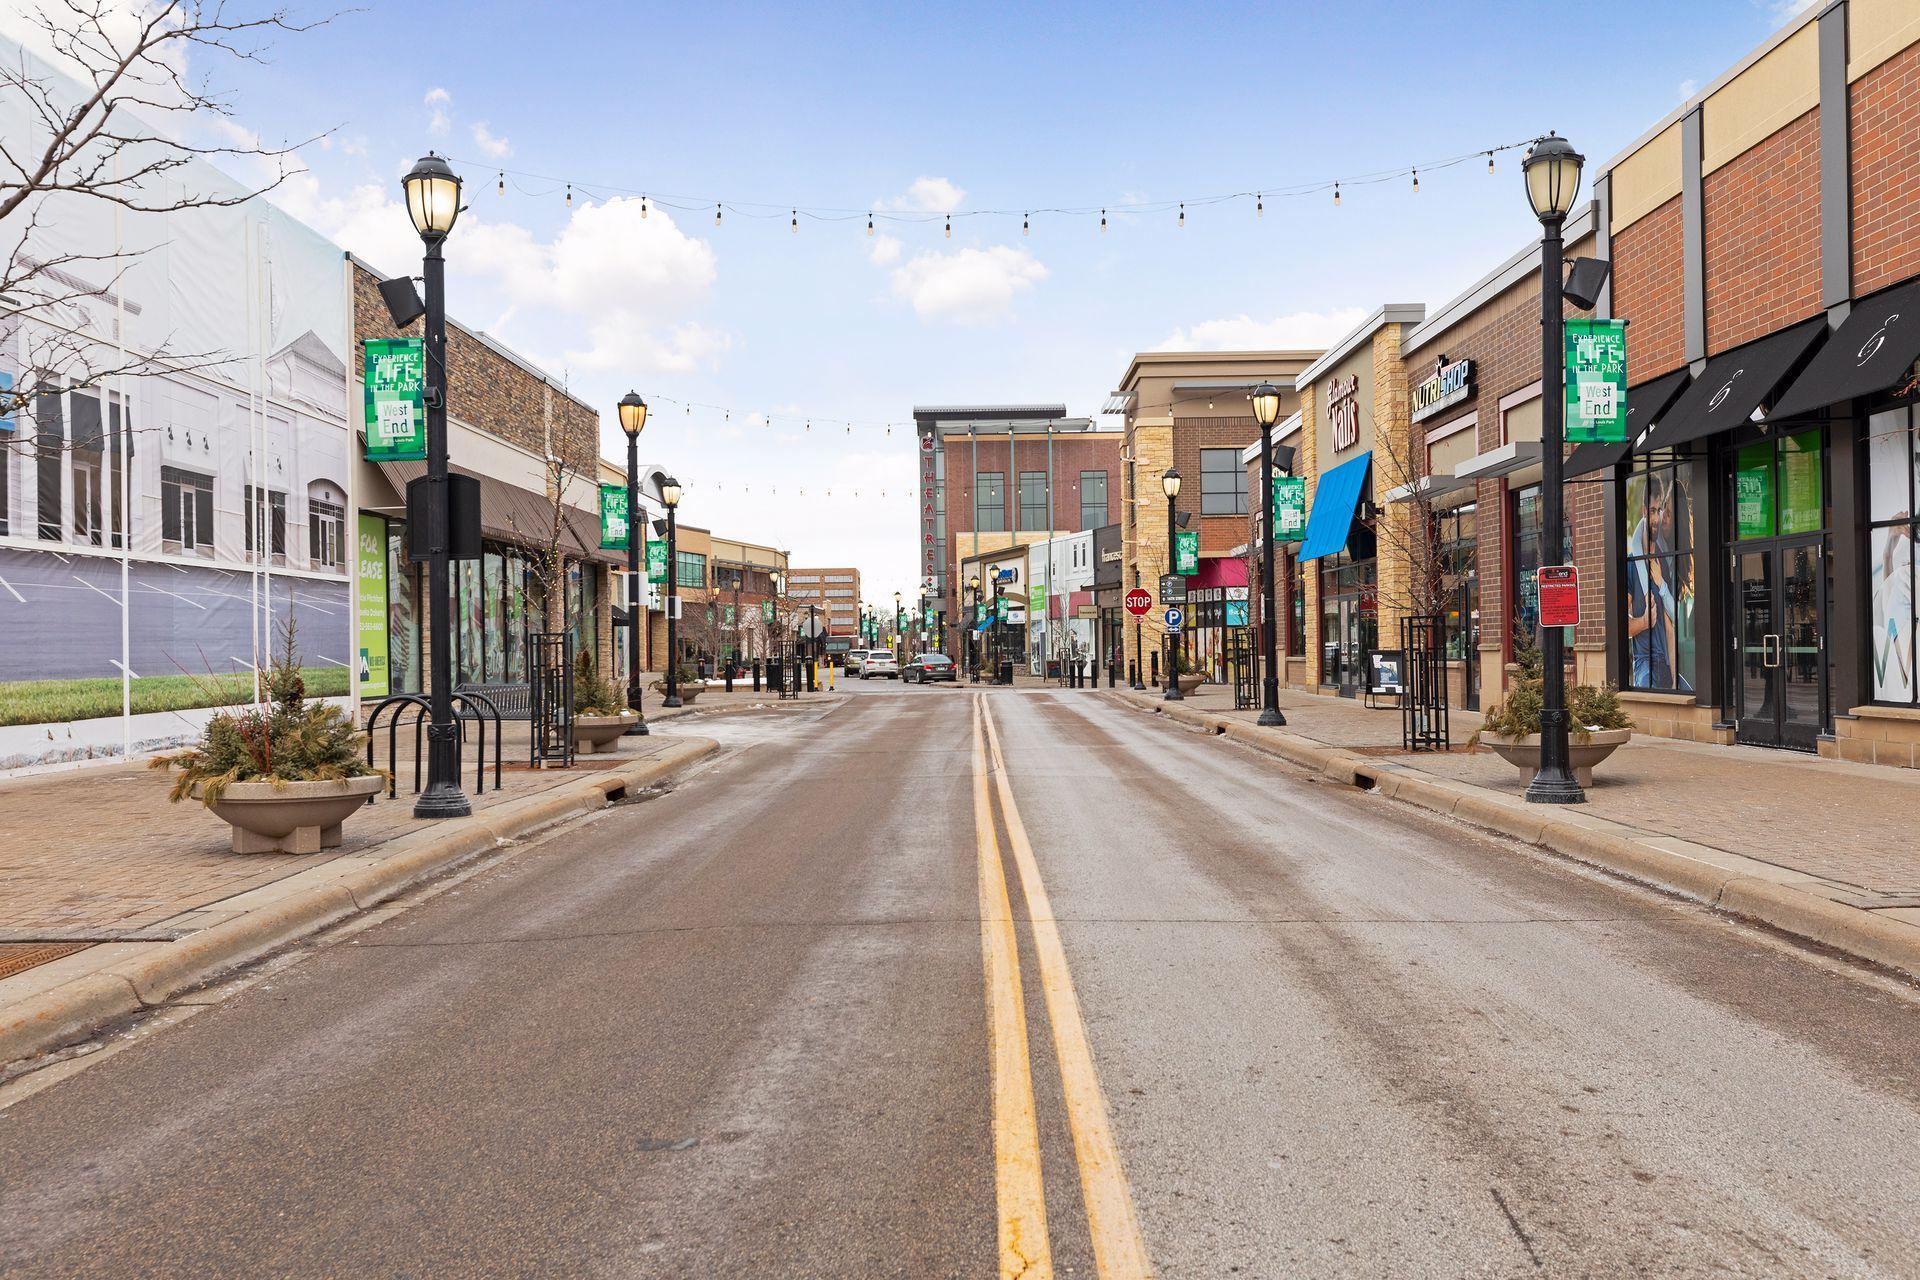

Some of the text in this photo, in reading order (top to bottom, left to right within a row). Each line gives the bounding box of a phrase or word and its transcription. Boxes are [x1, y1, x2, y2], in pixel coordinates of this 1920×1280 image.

[1572, 334, 1620, 344] EXPERIENCE
[372, 353, 419, 364] EXPERIENCE
[1576, 344, 1618, 364] LIFE
[375, 363, 415, 384] LIFE
[1572, 363, 1624, 374] IN THE PARK
[370, 381, 421, 393] IN THE PARK
[1586, 386, 1612, 398] West
[383, 404, 408, 417] West
[1585, 401, 1611, 415] End
[383, 419, 409, 435] End
[1332, 397, 1359, 453] Nails
[1279, 490, 1300, 500] LIFE
[606, 498, 625, 509] LIFE
[923, 456, 936, 576] THEATRES
[360, 535, 378, 554] FOR
[359, 560, 384, 580] EASE
[1127, 597, 1151, 607] STOP
[1169, 611, 1179, 623] P
